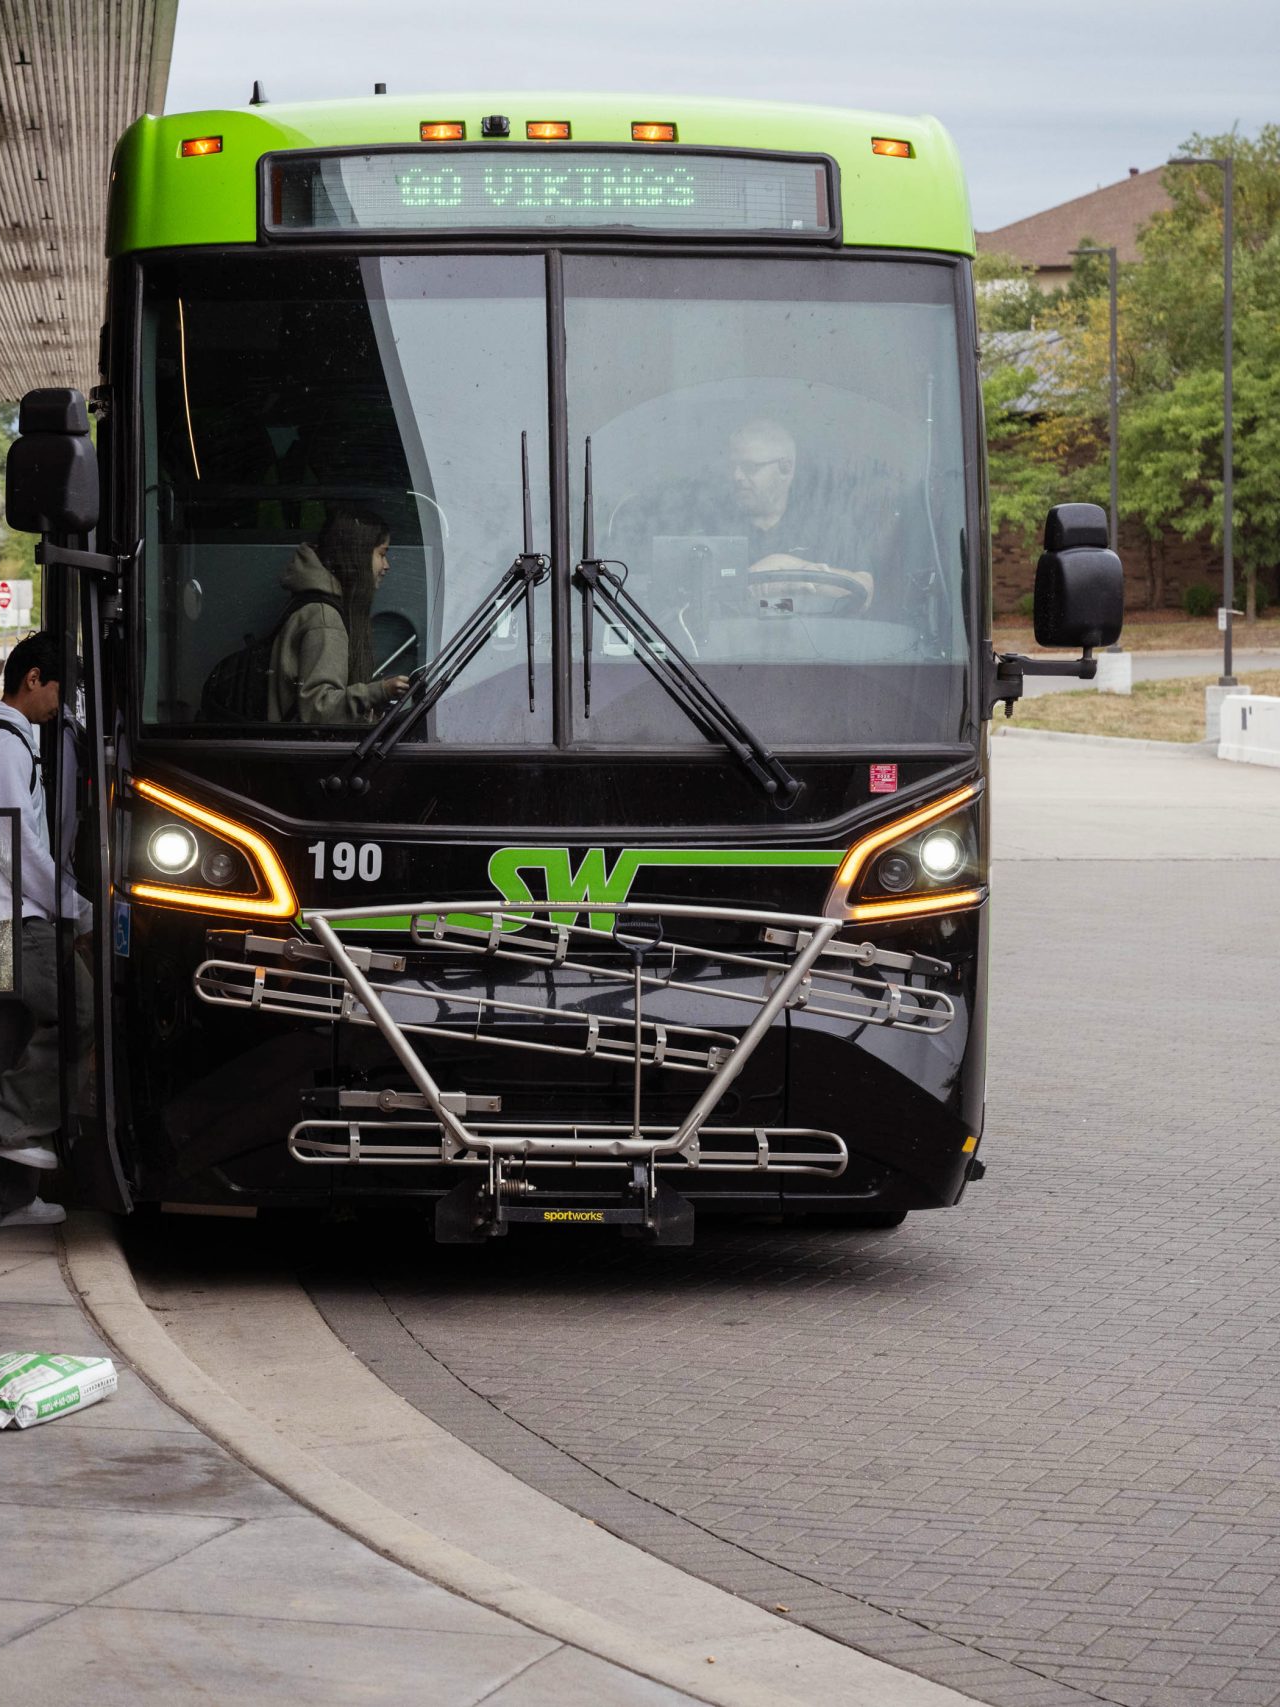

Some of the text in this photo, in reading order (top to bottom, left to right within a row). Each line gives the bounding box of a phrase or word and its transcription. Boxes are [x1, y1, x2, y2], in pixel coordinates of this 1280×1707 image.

[401, 168, 694, 206] GO VIKINGS
[308, 841, 382, 882] 190
[487, 847, 640, 934] SW
[543, 1210, 604, 1222] sportworks
